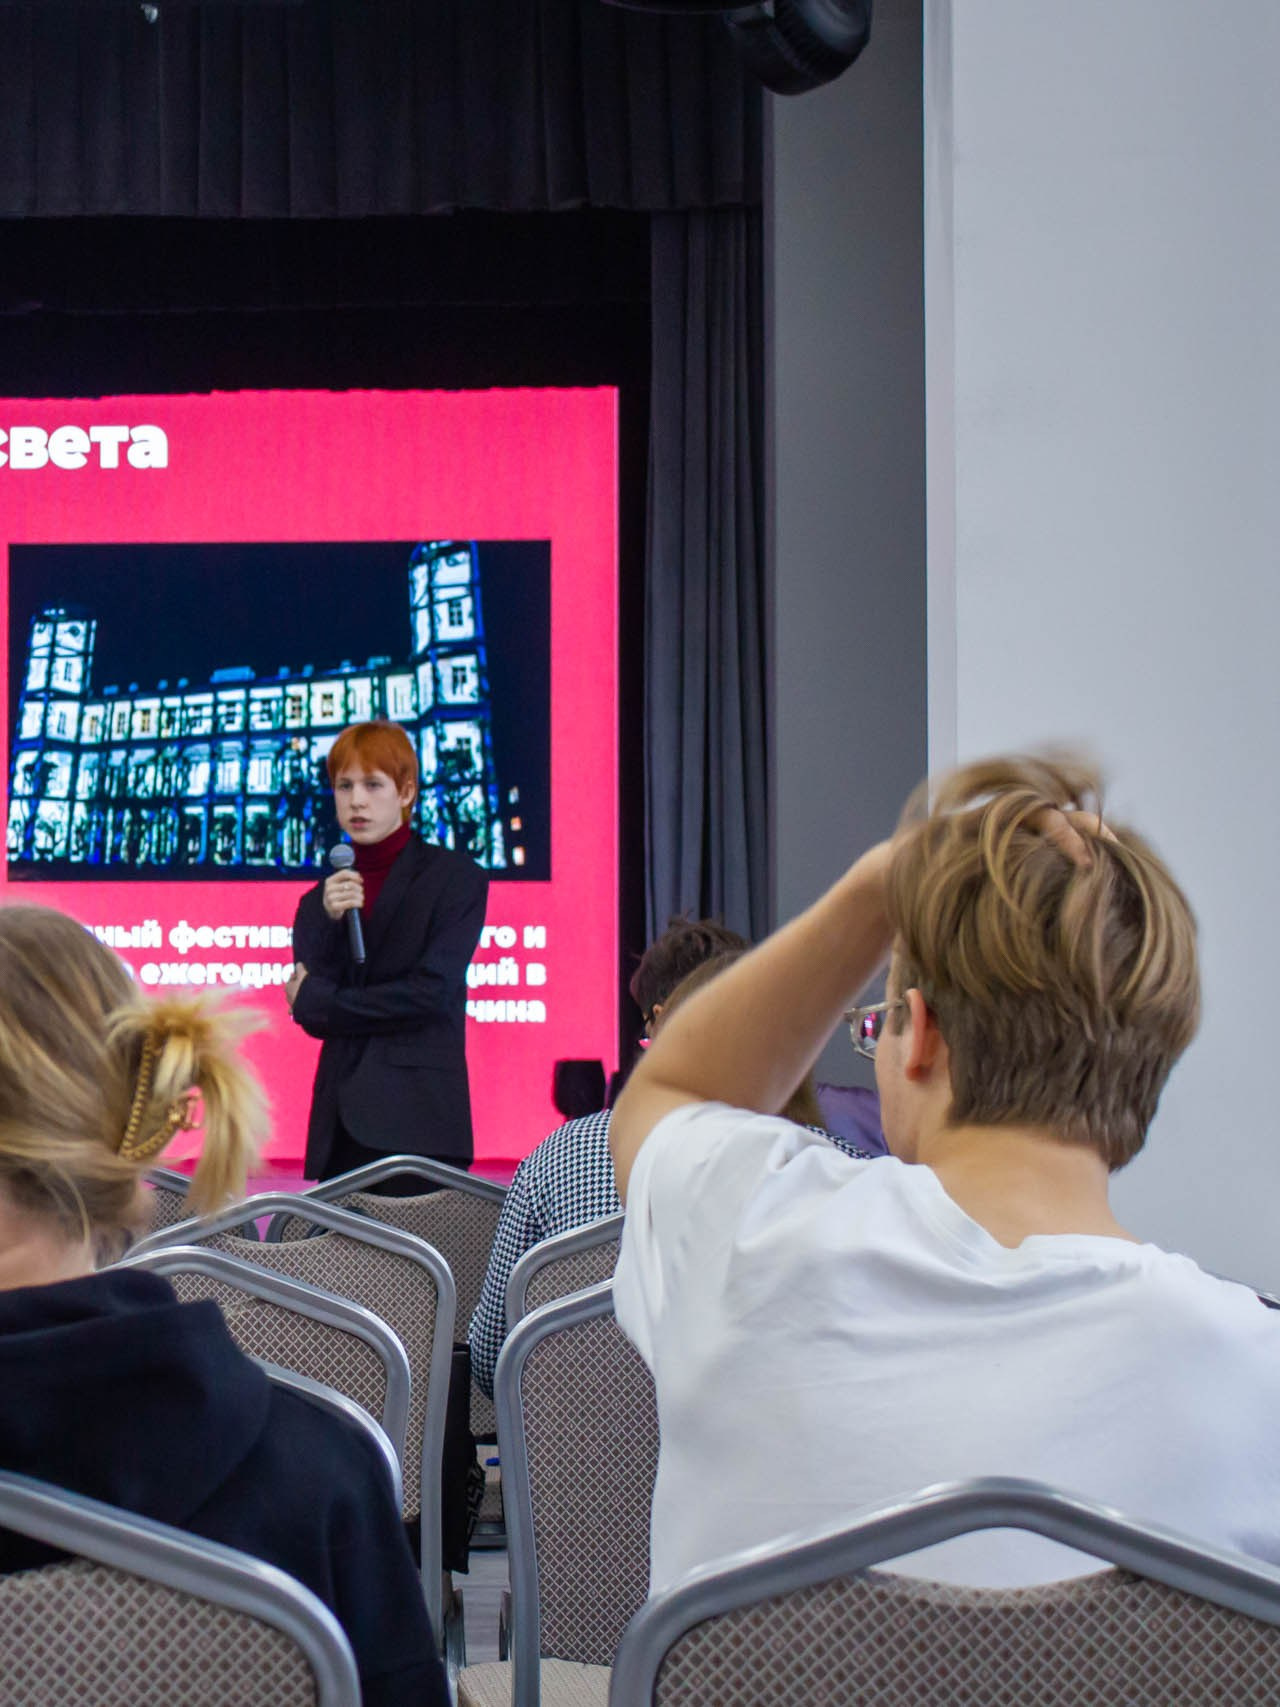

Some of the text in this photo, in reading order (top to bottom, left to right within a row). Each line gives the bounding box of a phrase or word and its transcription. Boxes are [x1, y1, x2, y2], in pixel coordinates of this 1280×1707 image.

[83, 919, 547, 954] ный фестив го и
[466, 999, 547, 1023] чина
